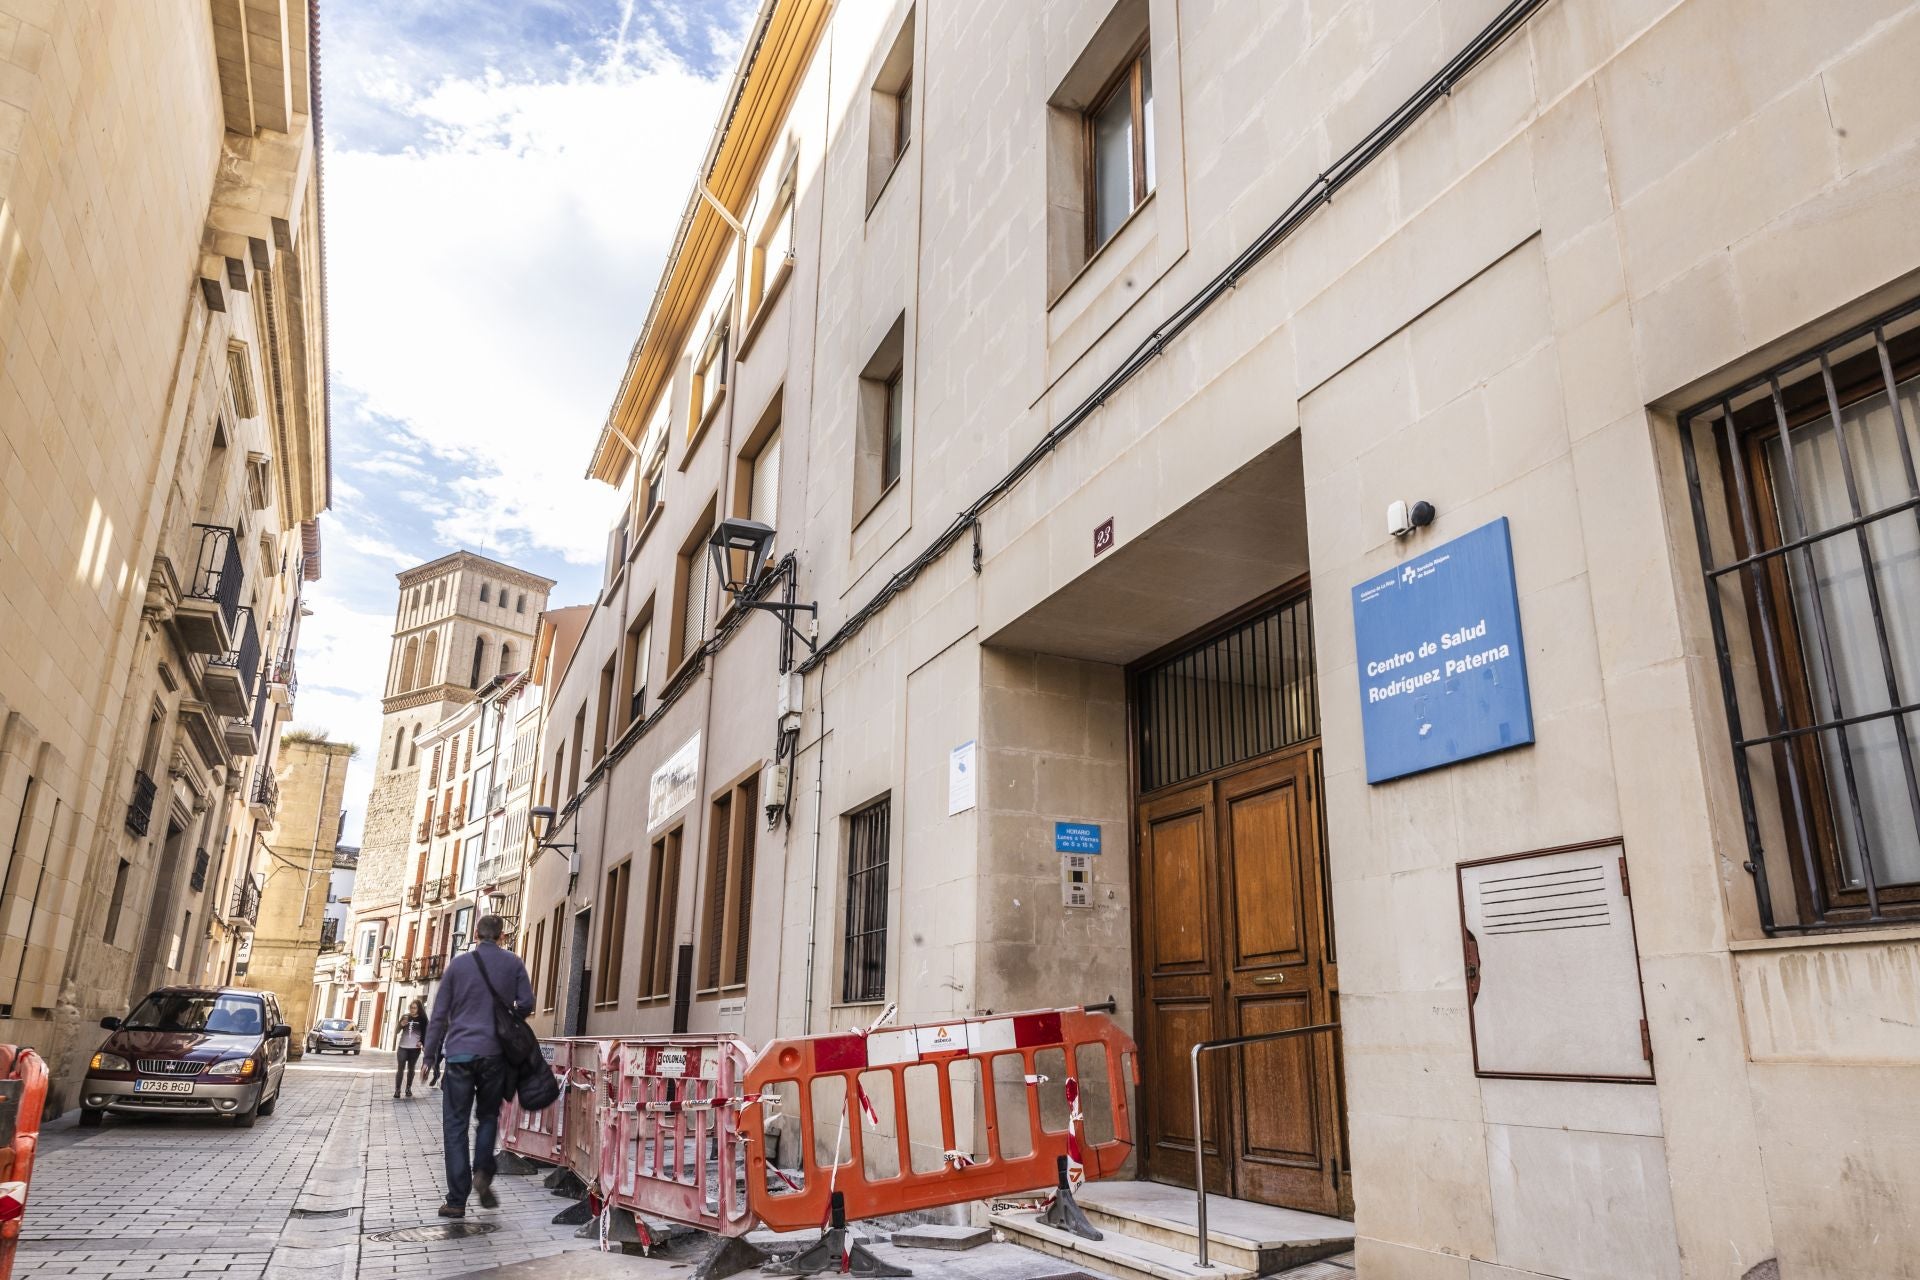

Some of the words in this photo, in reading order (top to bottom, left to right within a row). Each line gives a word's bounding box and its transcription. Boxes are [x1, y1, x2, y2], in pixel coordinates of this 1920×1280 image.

[1096, 526, 1110, 548] 23
[1367, 651, 1414, 676] Centro
[1418, 641, 1437, 658] de
[1441, 619, 1486, 649] Salud
[1369, 668, 1440, 703] Rodríguez
[1445, 644, 1509, 677] Paterna
[142, 1081, 168, 1091] 0736
[171, 1082, 191, 1092] BGD
